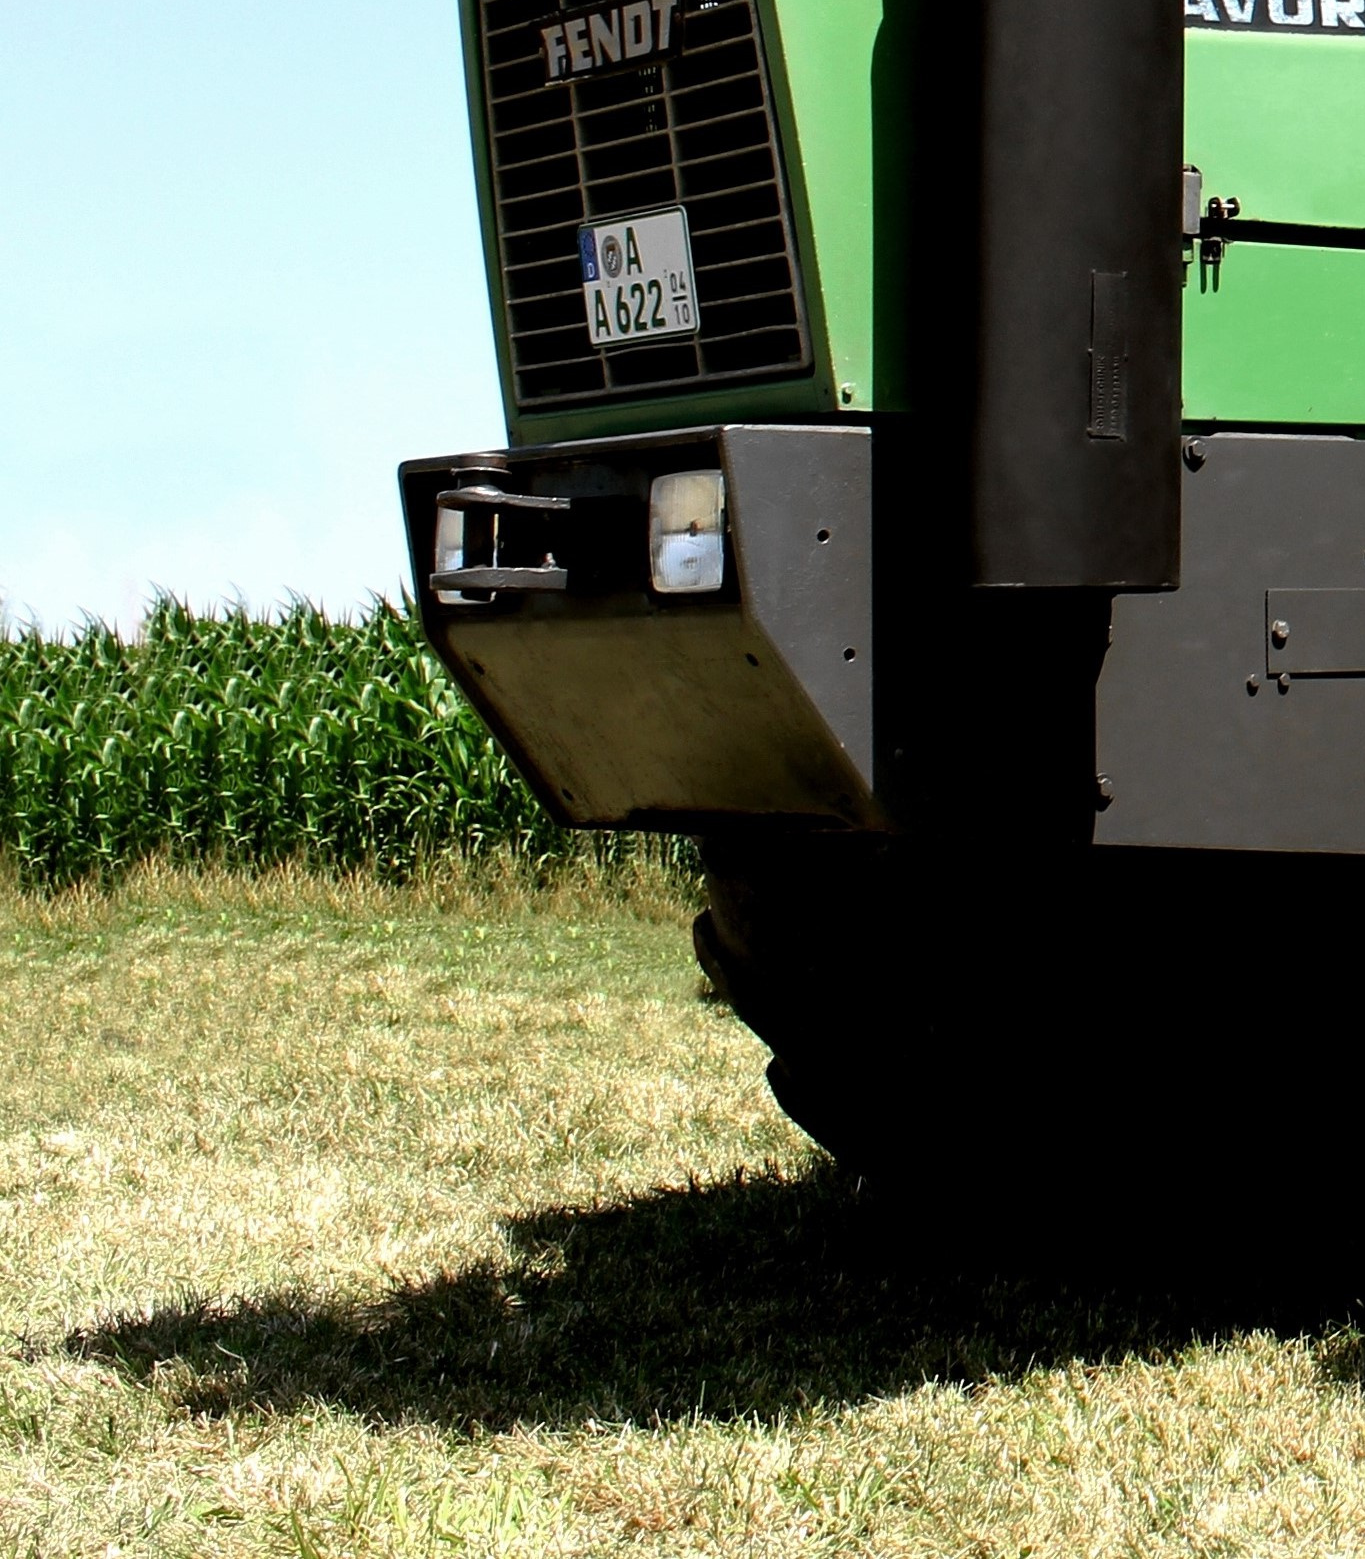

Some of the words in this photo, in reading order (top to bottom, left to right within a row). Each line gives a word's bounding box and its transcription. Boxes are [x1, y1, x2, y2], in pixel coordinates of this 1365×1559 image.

[586, 262, 595, 279] D
[626, 226, 643, 275] A
[616, 279, 667, 334] 622
